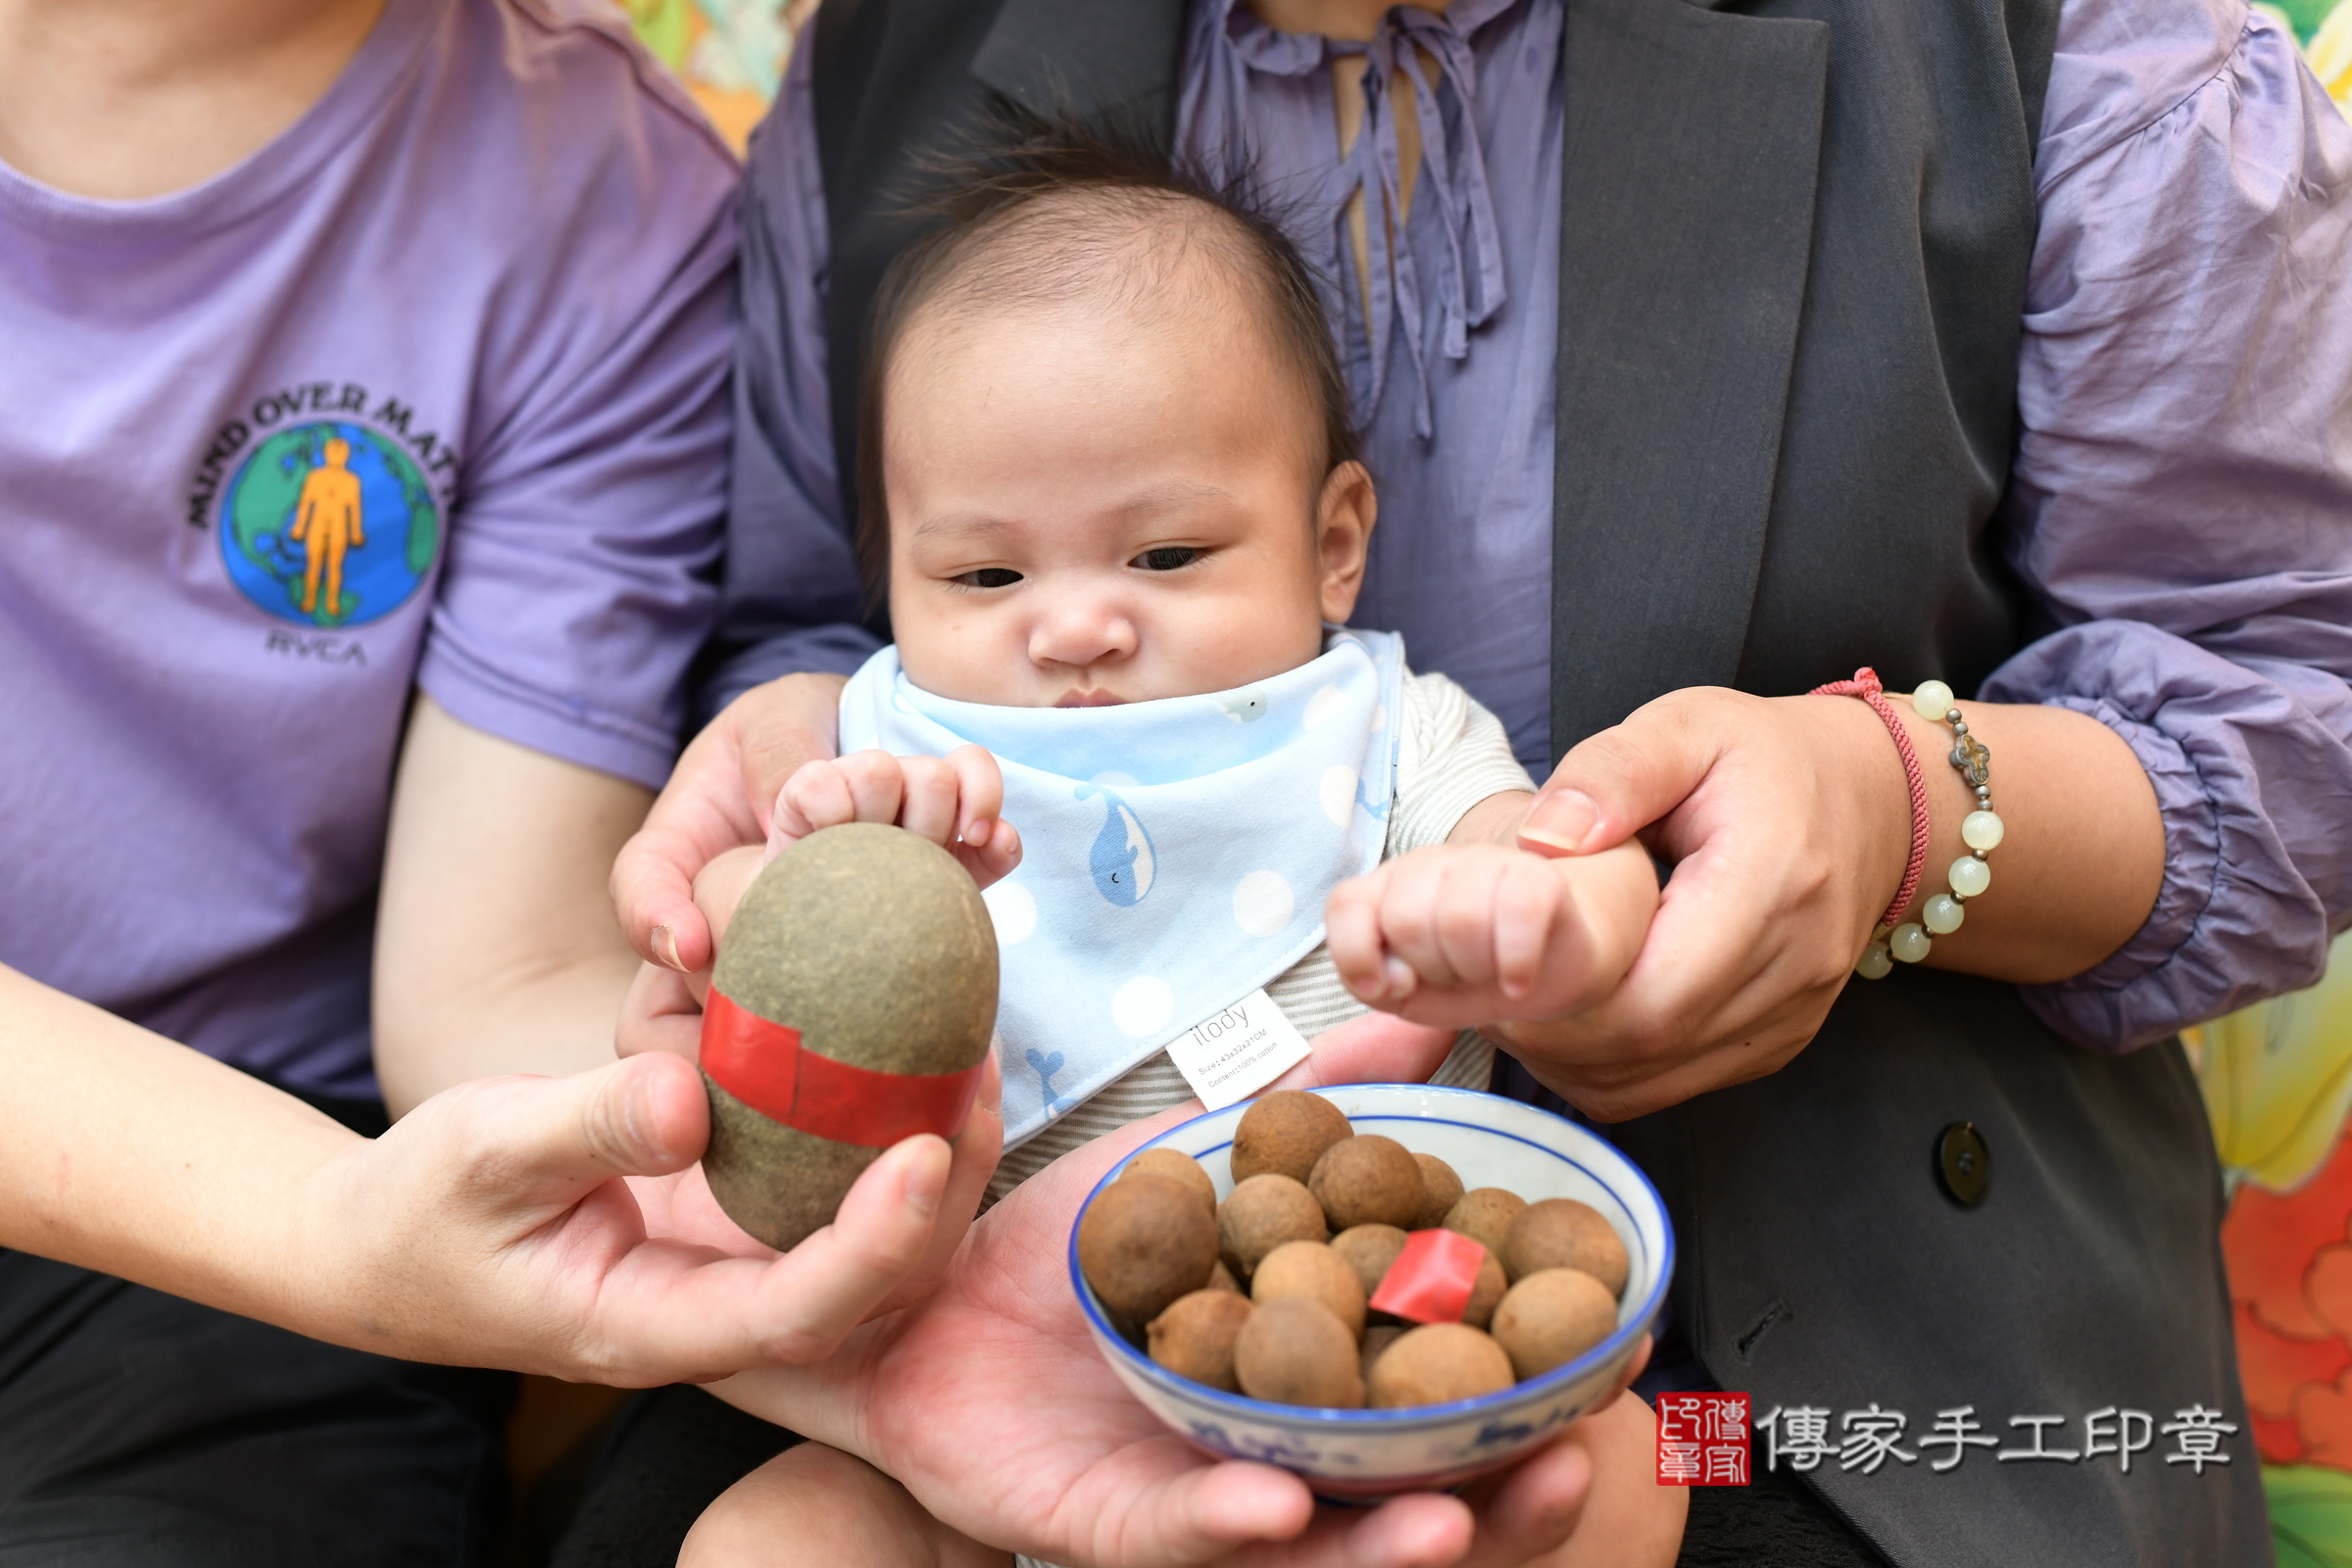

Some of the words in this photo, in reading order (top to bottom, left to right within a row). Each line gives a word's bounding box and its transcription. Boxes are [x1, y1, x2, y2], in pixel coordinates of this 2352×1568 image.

[188, 421, 249, 530] MIND
[253, 382, 368, 426] OVER
[265, 631, 367, 666] RVCA
[1189, 1005, 1249, 1047] ilody
[1257, 1042, 1278, 1059] cotton
